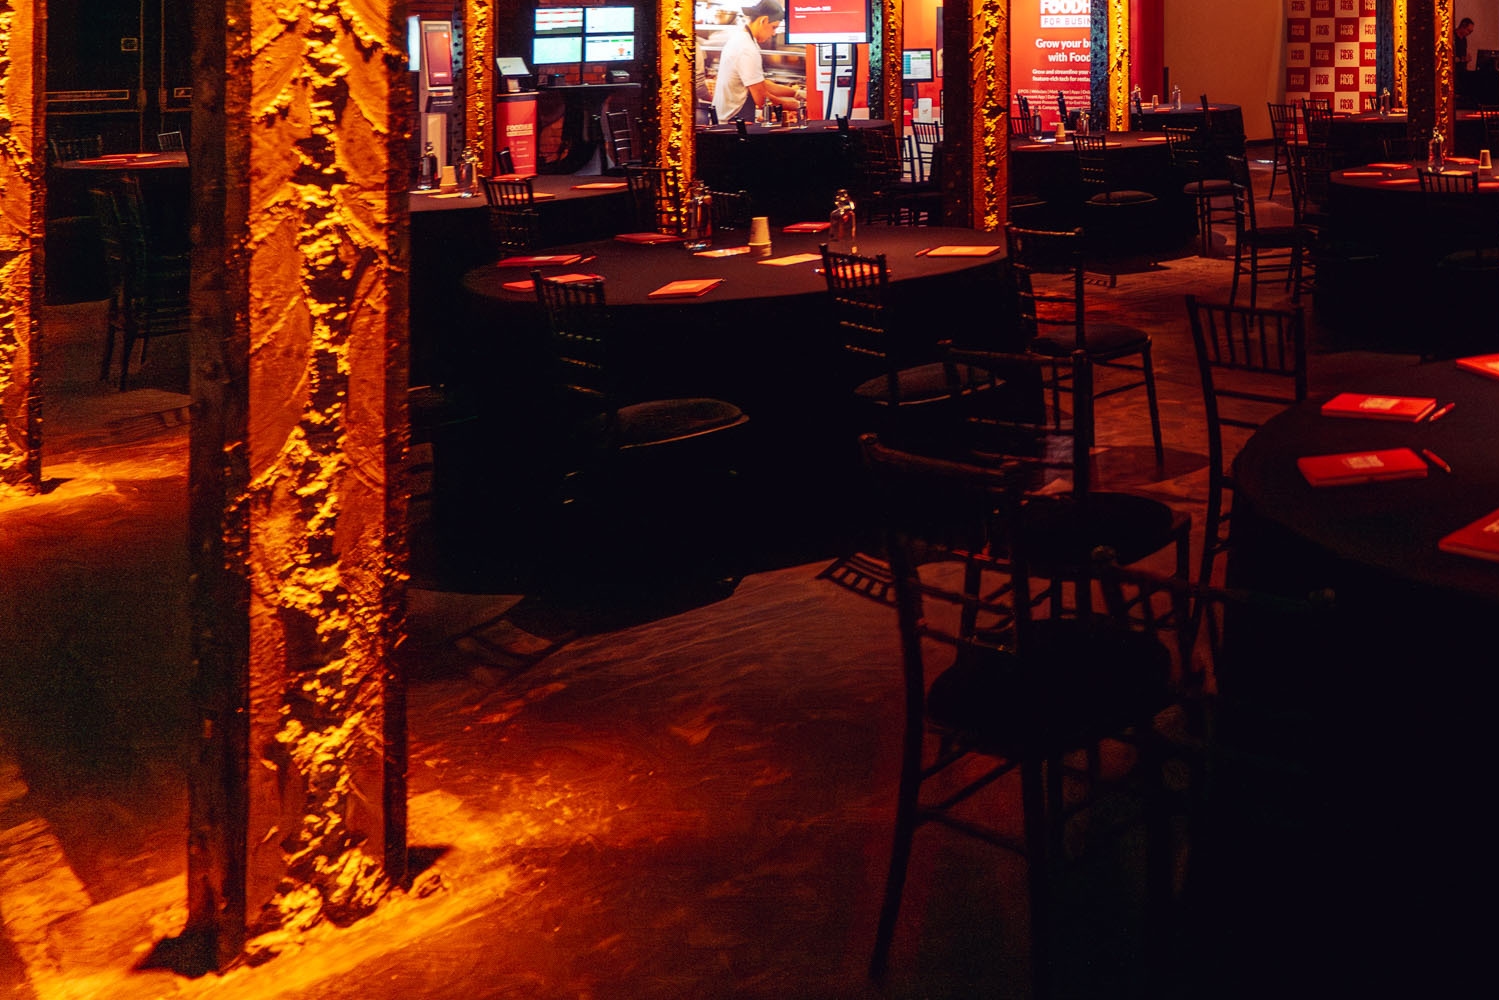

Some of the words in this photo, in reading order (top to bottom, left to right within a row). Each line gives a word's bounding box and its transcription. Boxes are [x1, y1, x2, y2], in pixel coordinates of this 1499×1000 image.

[1035, 38, 1060, 48] Grow
[1060, 39, 1081, 50] your
[1048, 52, 1068, 62] with
